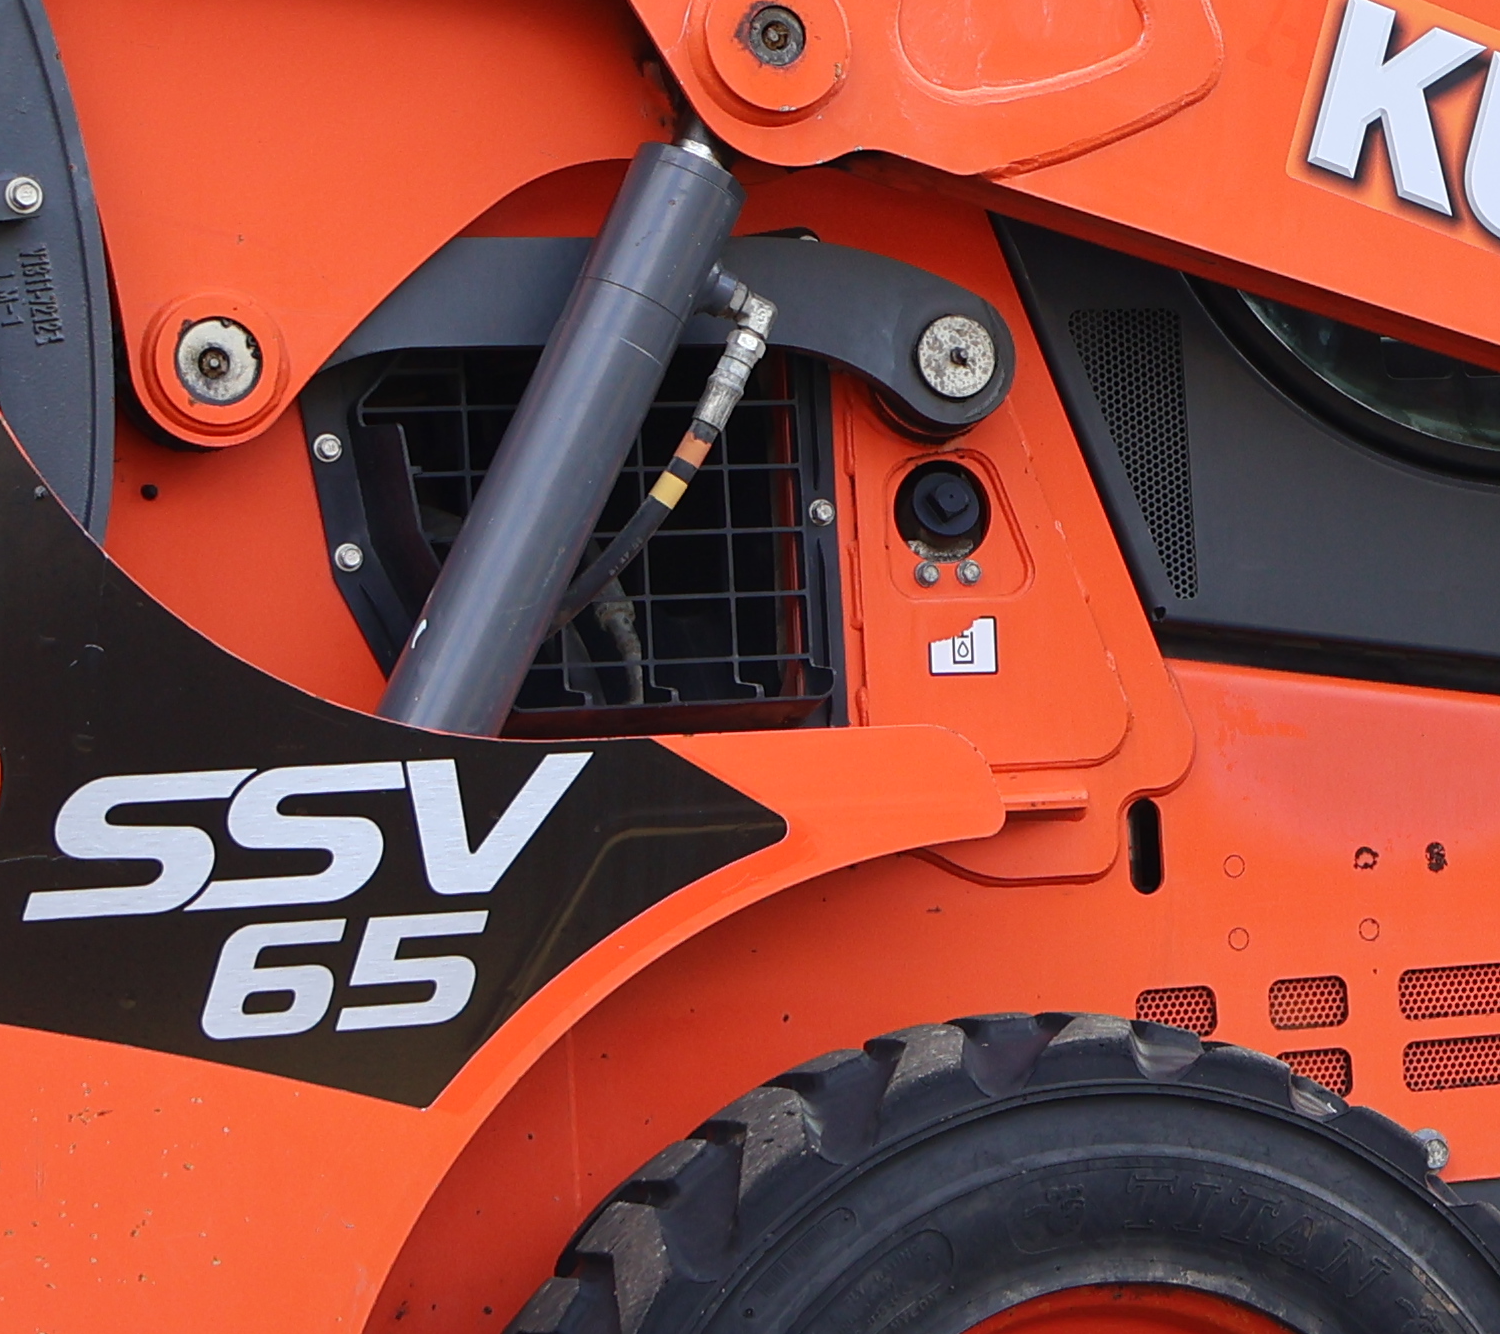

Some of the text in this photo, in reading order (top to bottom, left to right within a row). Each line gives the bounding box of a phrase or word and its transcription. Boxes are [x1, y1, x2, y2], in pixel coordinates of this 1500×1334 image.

[22, 752, 594, 921] SSV
[201, 910, 490, 1040] 65
[1123, 1172, 1391, 1298] TITAN
